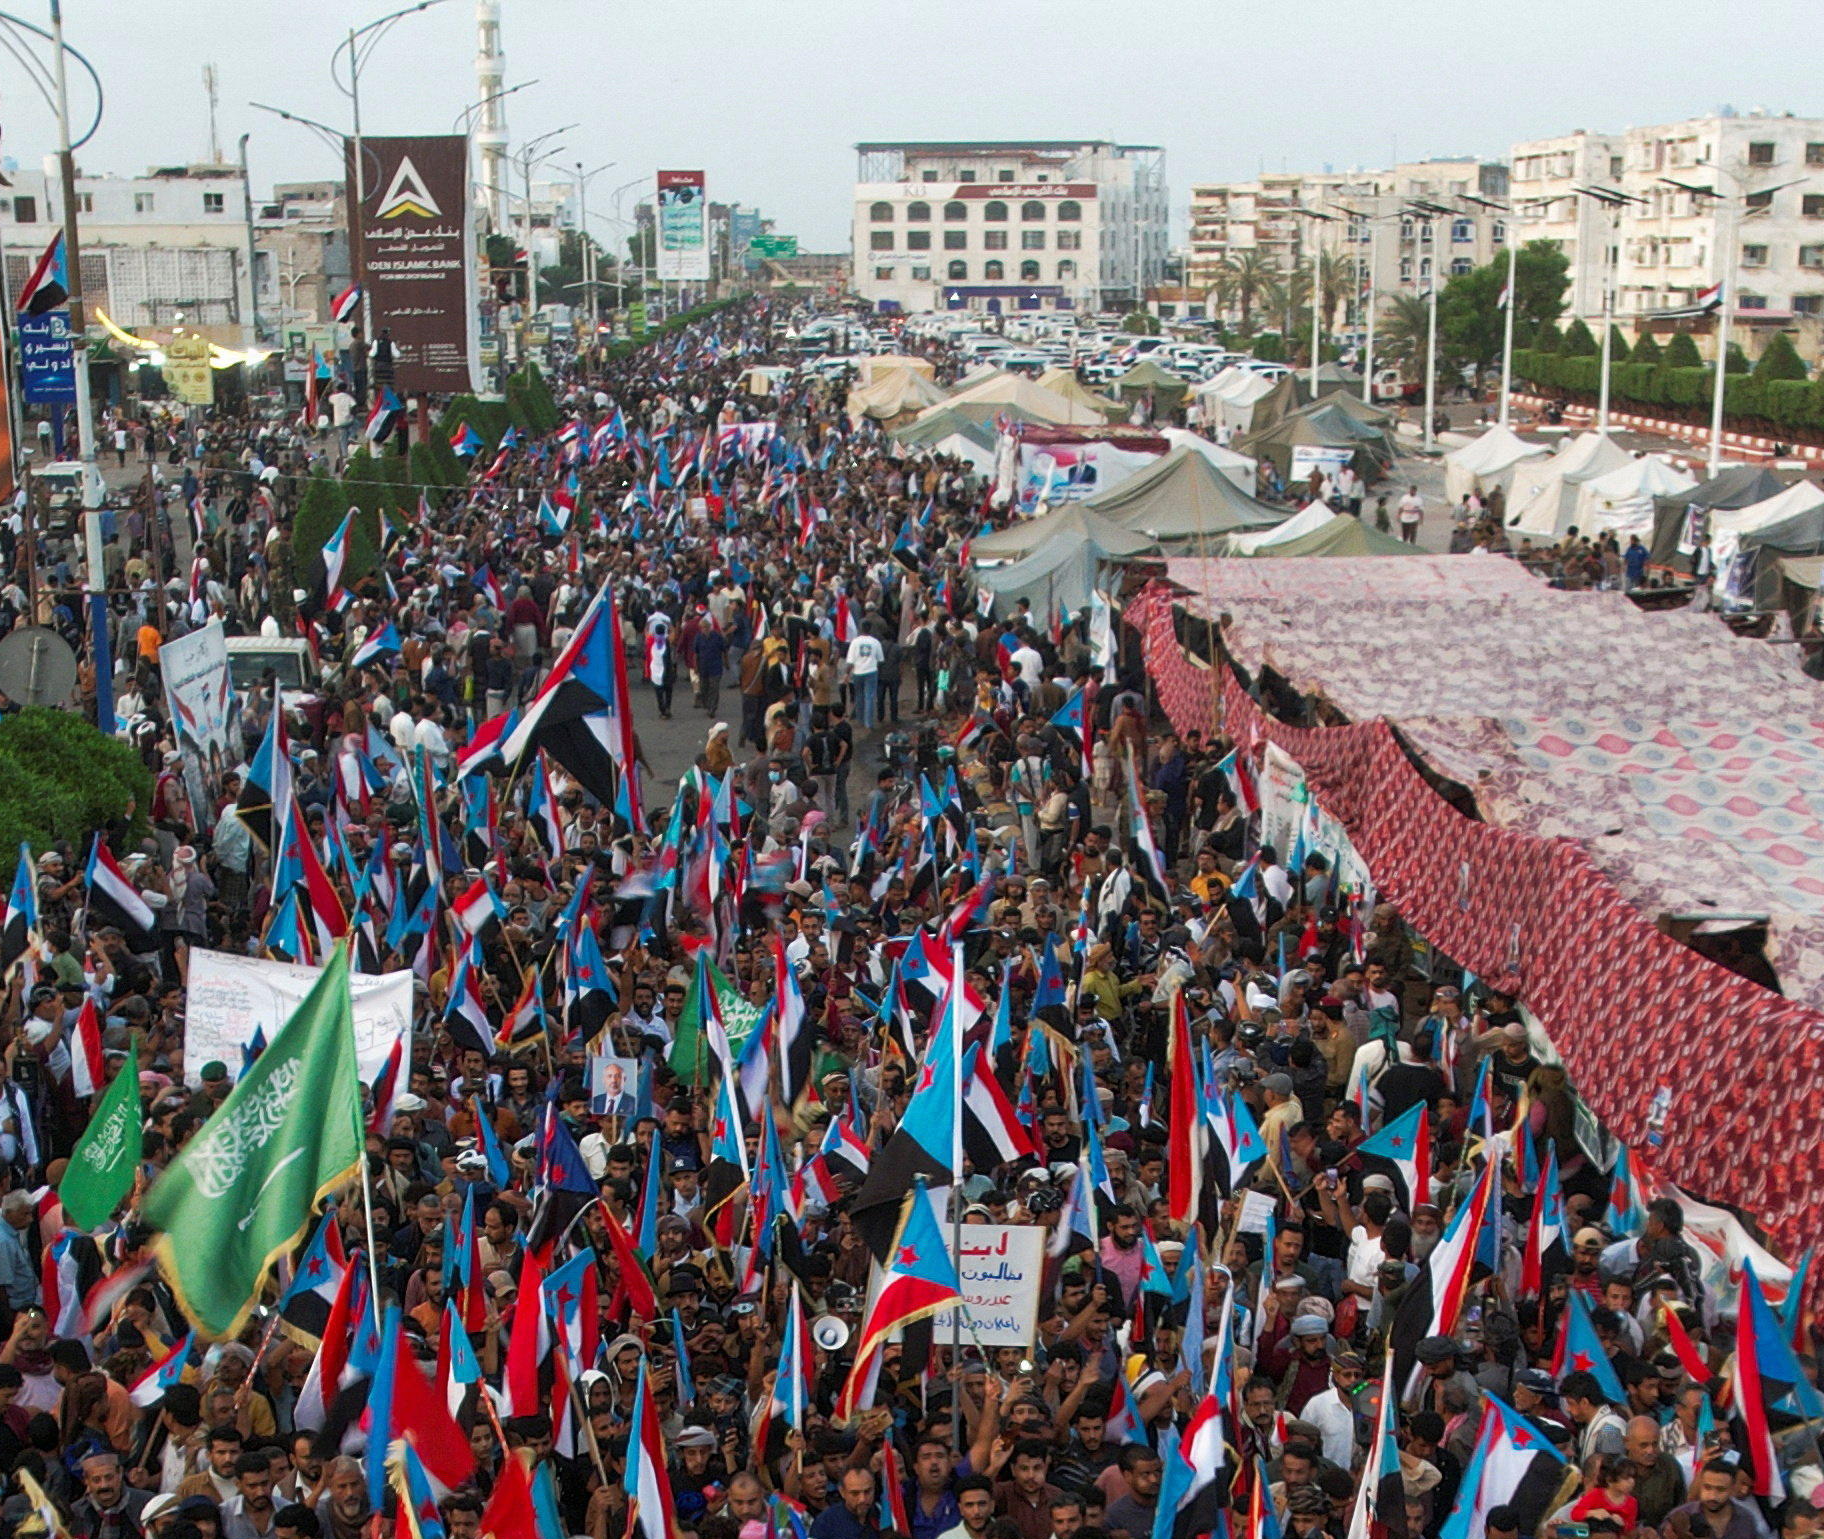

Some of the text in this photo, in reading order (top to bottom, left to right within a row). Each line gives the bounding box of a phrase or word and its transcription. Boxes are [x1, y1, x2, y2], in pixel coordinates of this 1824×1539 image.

[432, 224, 460, 240] بنك
[392, 260, 432, 270] ISLAMIC
[432, 260, 462, 270] BANK
